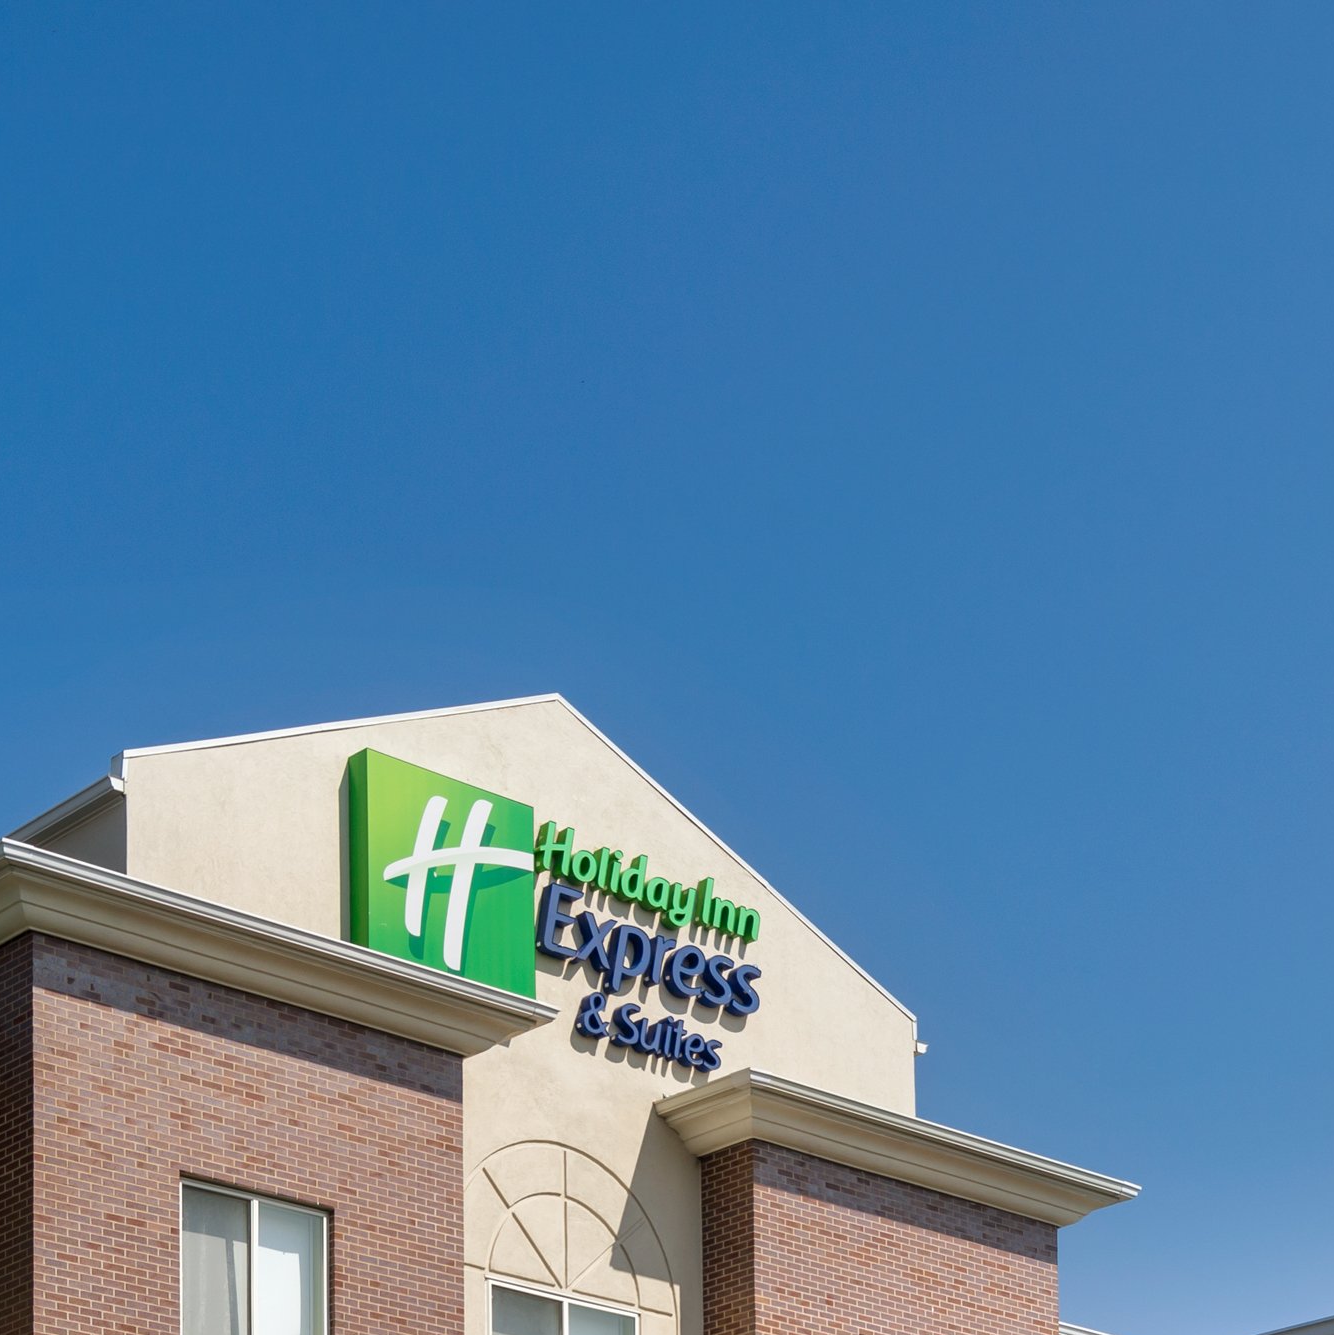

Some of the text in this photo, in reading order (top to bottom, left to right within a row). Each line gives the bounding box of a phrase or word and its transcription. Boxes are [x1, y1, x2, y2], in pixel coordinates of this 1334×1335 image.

[535, 821, 760, 944] Holiday Inn
[536, 882, 762, 1017] Express
[576, 992, 722, 1073] & Suites
